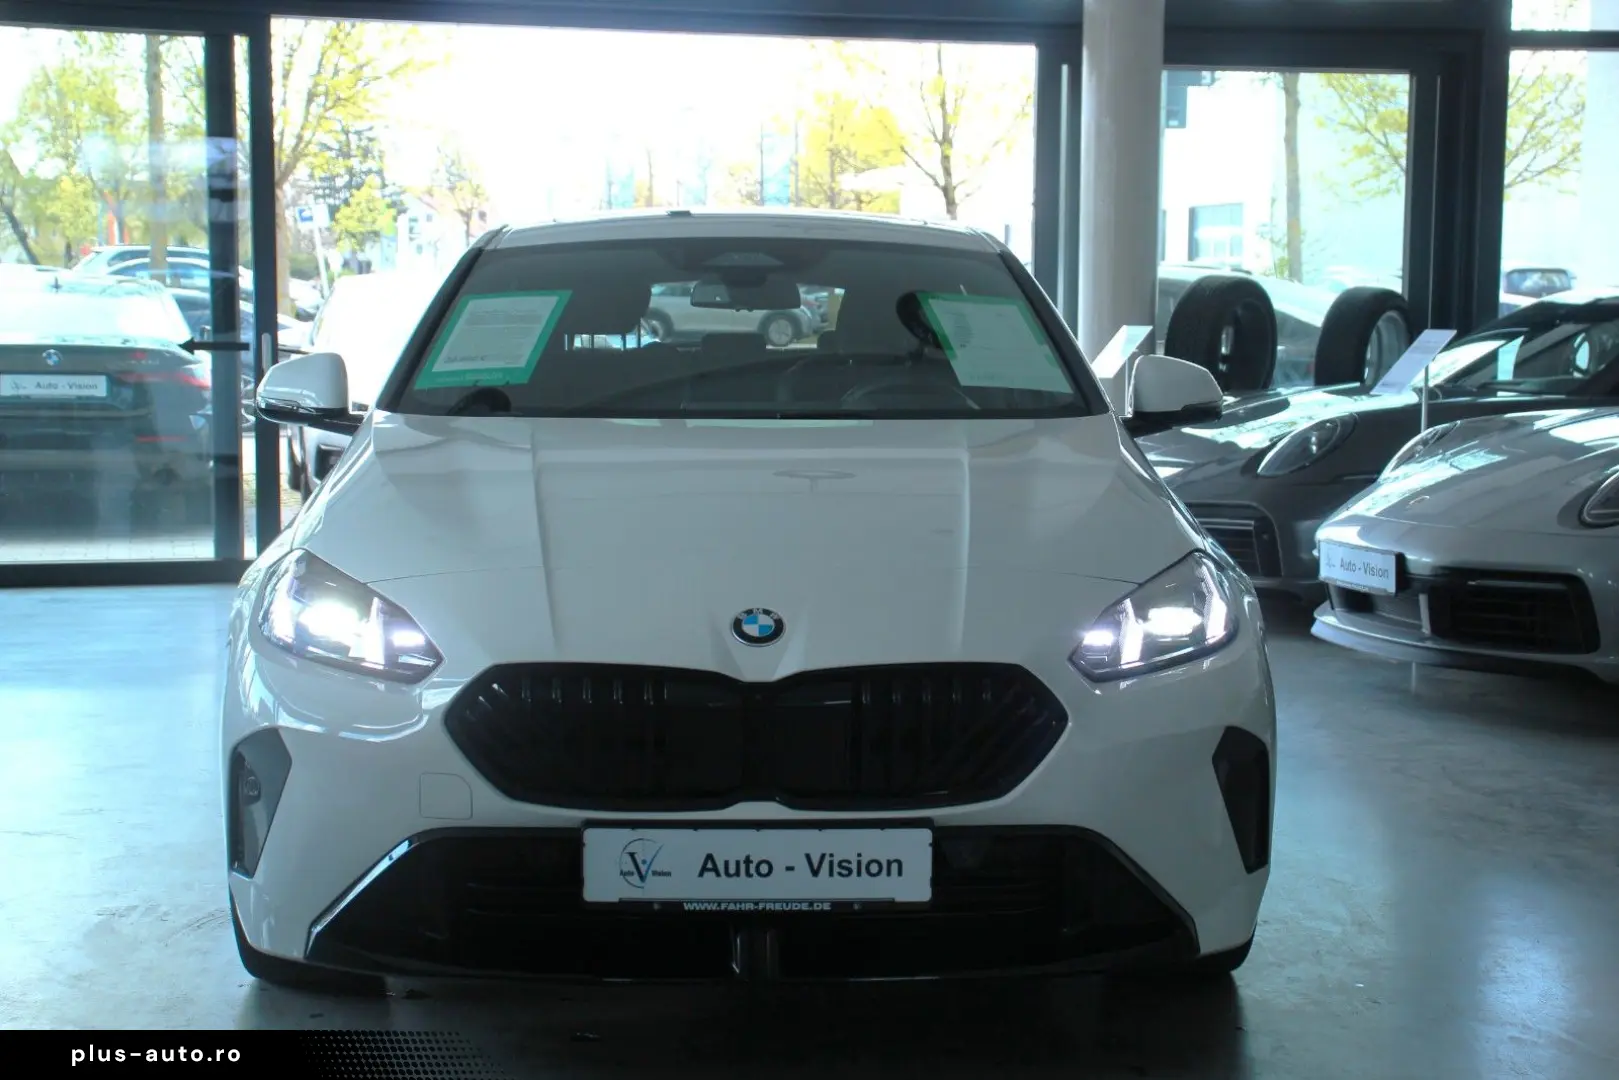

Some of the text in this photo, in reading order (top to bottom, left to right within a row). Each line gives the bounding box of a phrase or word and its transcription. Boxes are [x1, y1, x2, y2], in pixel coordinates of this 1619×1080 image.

[34, 381, 58, 390] Auto
[1340, 557, 1357, 573] Auto
[1362, 561, 1389, 578] Vision
[697, 852, 774, 878] Auto
[804, 852, 903, 878] Vision
[683, 902, 831, 911] WWW.FAHR-FREUDE.DE
